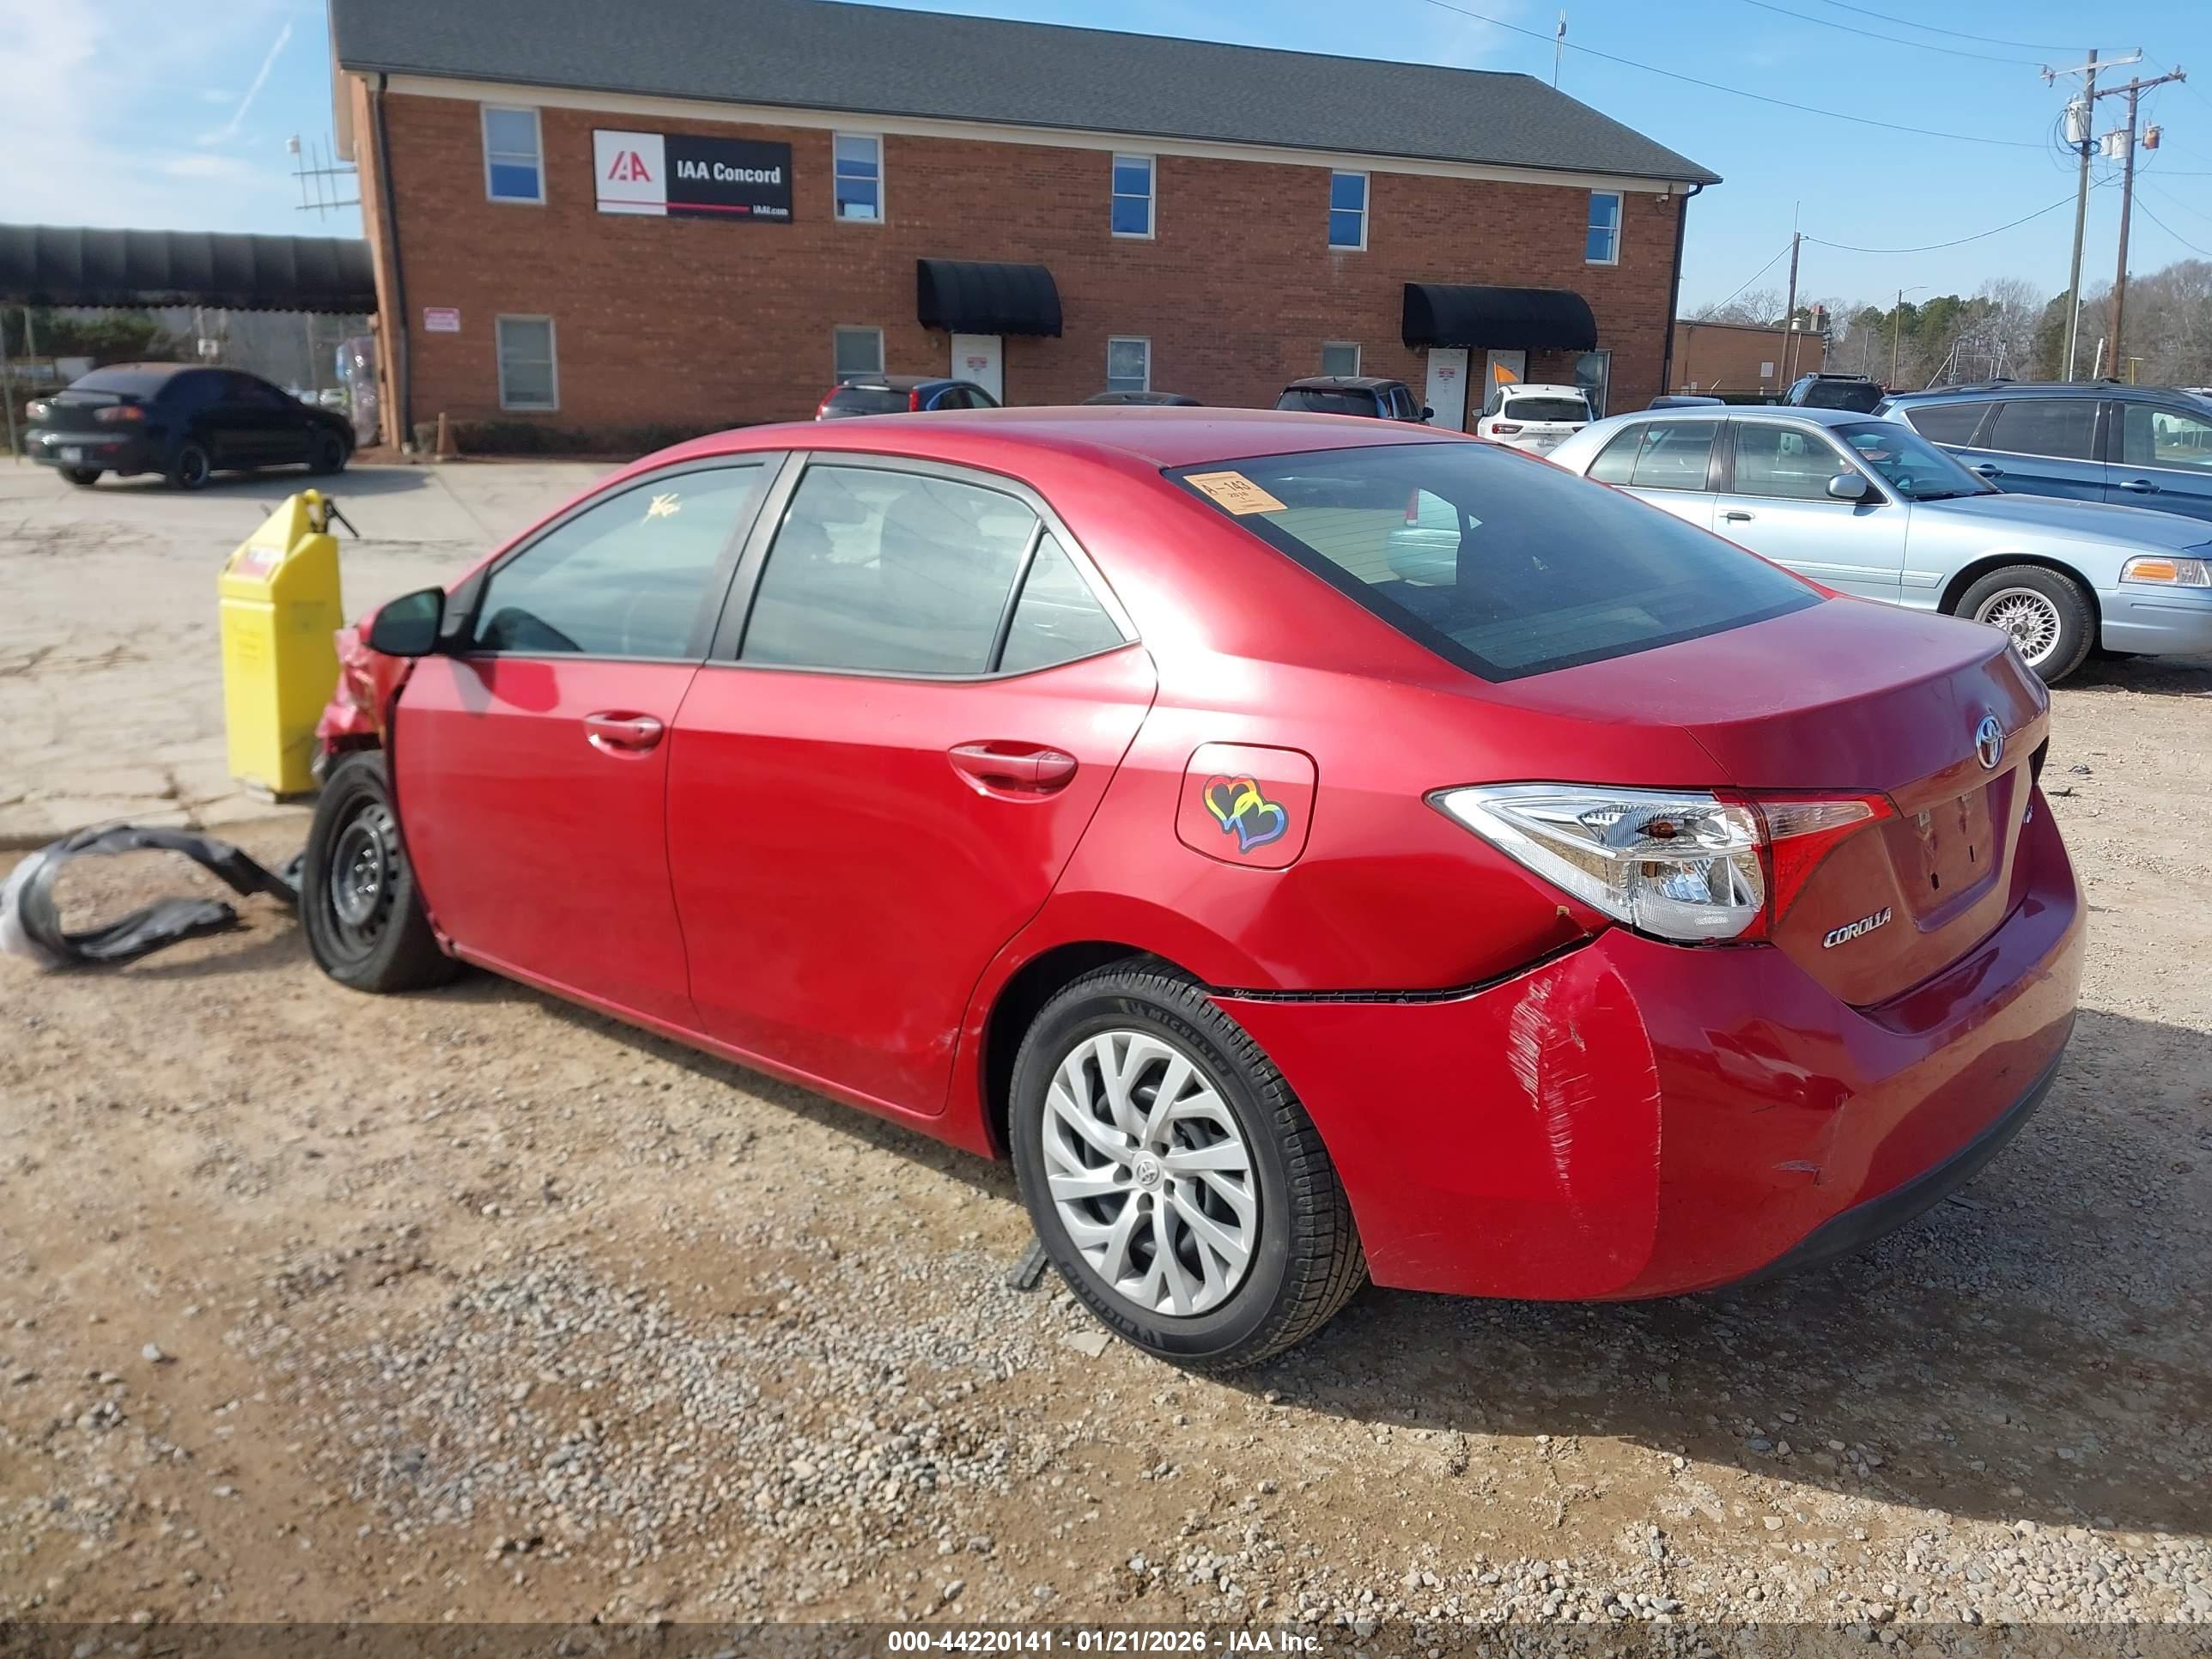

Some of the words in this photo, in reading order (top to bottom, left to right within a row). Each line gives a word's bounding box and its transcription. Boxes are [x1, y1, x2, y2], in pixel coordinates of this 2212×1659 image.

[677, 160, 709, 179] IAA
[713, 161, 781, 185] Concord
[1822, 906, 1892, 949] COROLLA
